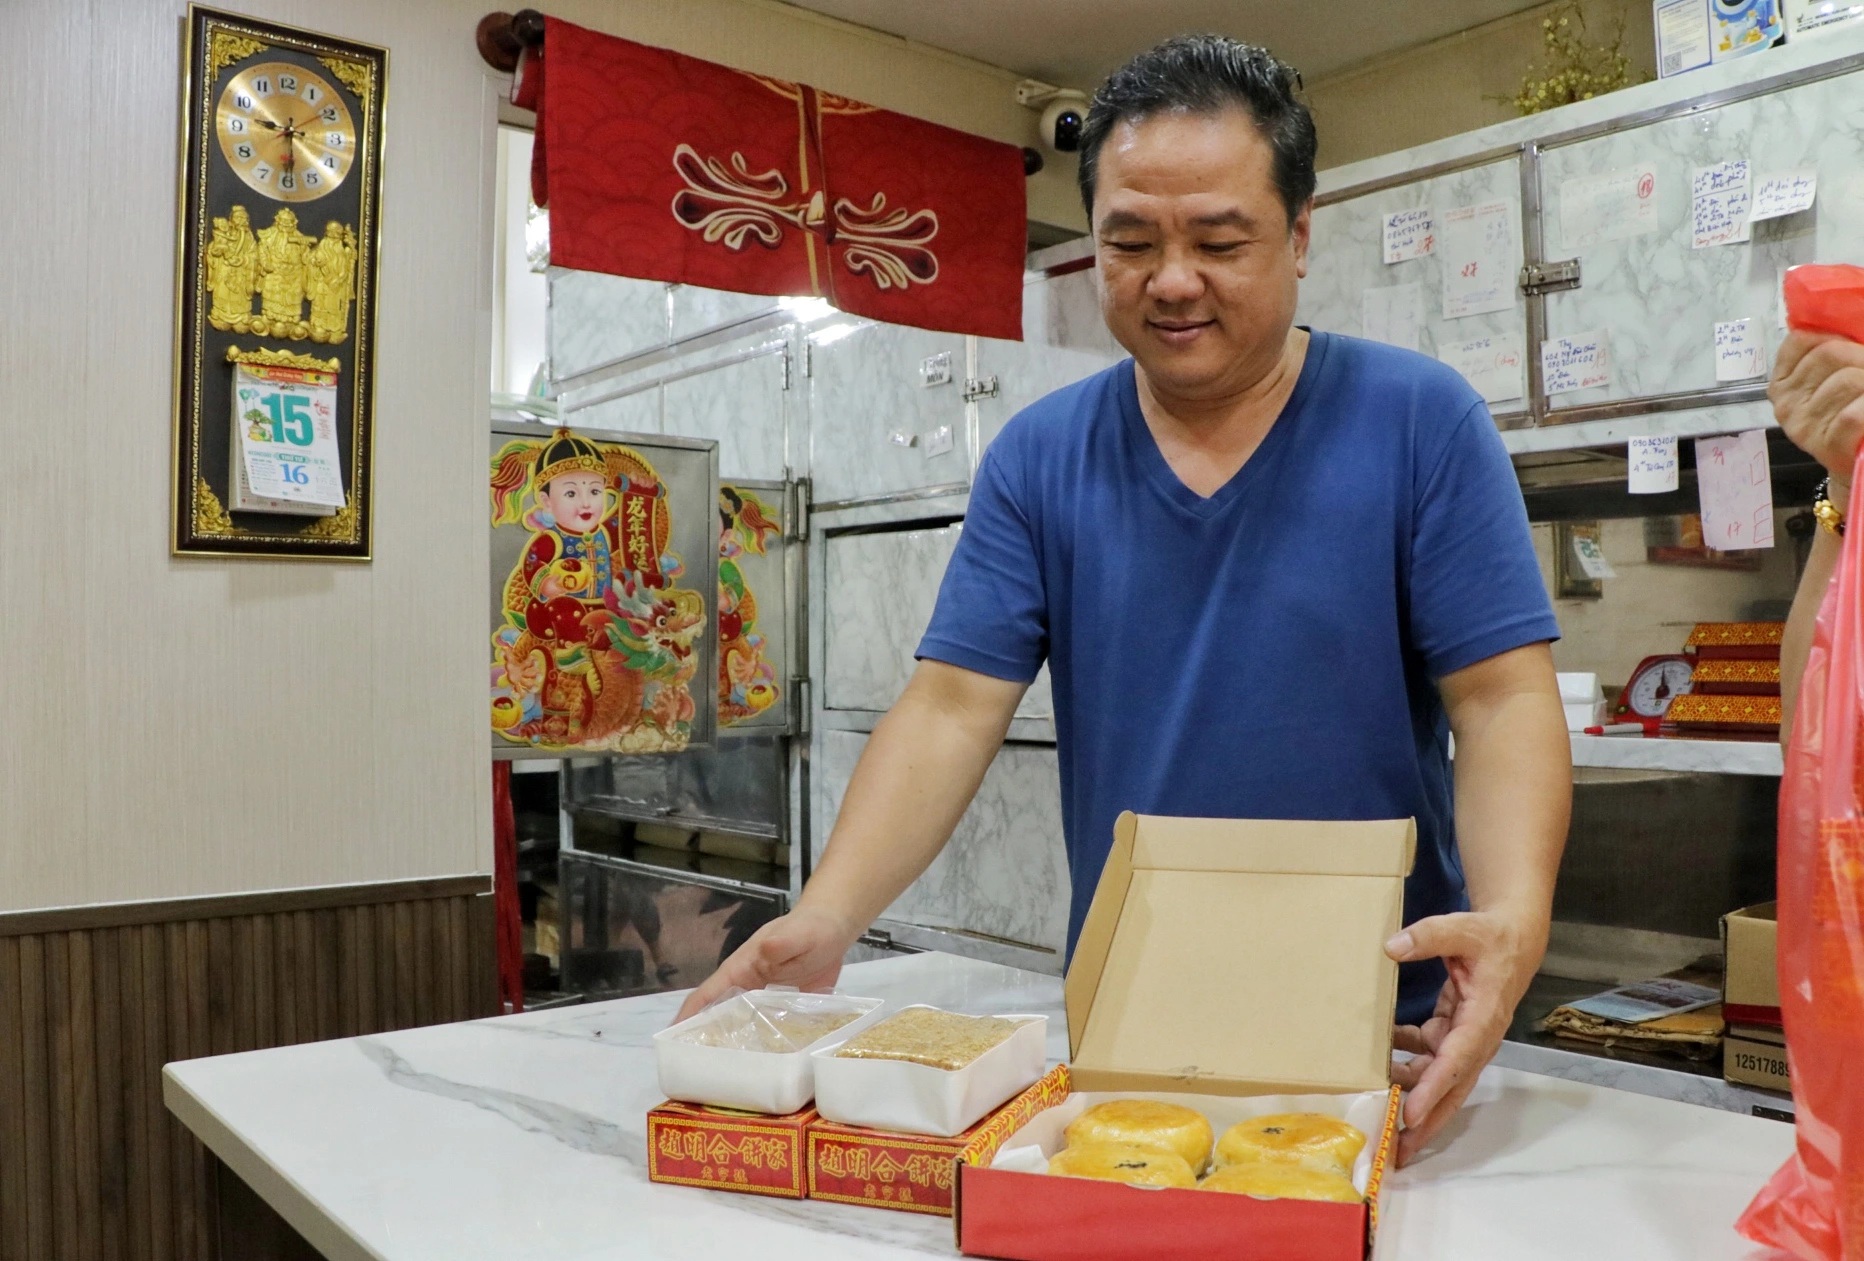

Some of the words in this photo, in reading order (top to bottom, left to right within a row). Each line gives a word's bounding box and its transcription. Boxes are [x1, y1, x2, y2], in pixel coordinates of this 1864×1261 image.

[256, 81, 268, 93] 11
[280, 77, 296, 90] 12
[309, 88, 315, 100] 1
[237, 96, 251, 109] 10
[322, 107, 336, 121] 2
[231, 119, 243, 132] 9
[330, 133, 341, 145] 3
[238, 145, 251, 158] 8
[323, 157, 335, 168] 4
[256, 168, 269, 179] 7
[306, 173, 318, 185] 5
[281, 175, 294, 188] 6
[260, 392, 314, 446] 15
[279, 463, 309, 485] 16
[626, 495, 651, 573] 龙年好运
[658, 1127, 788, 1170] 趙明合餅家
